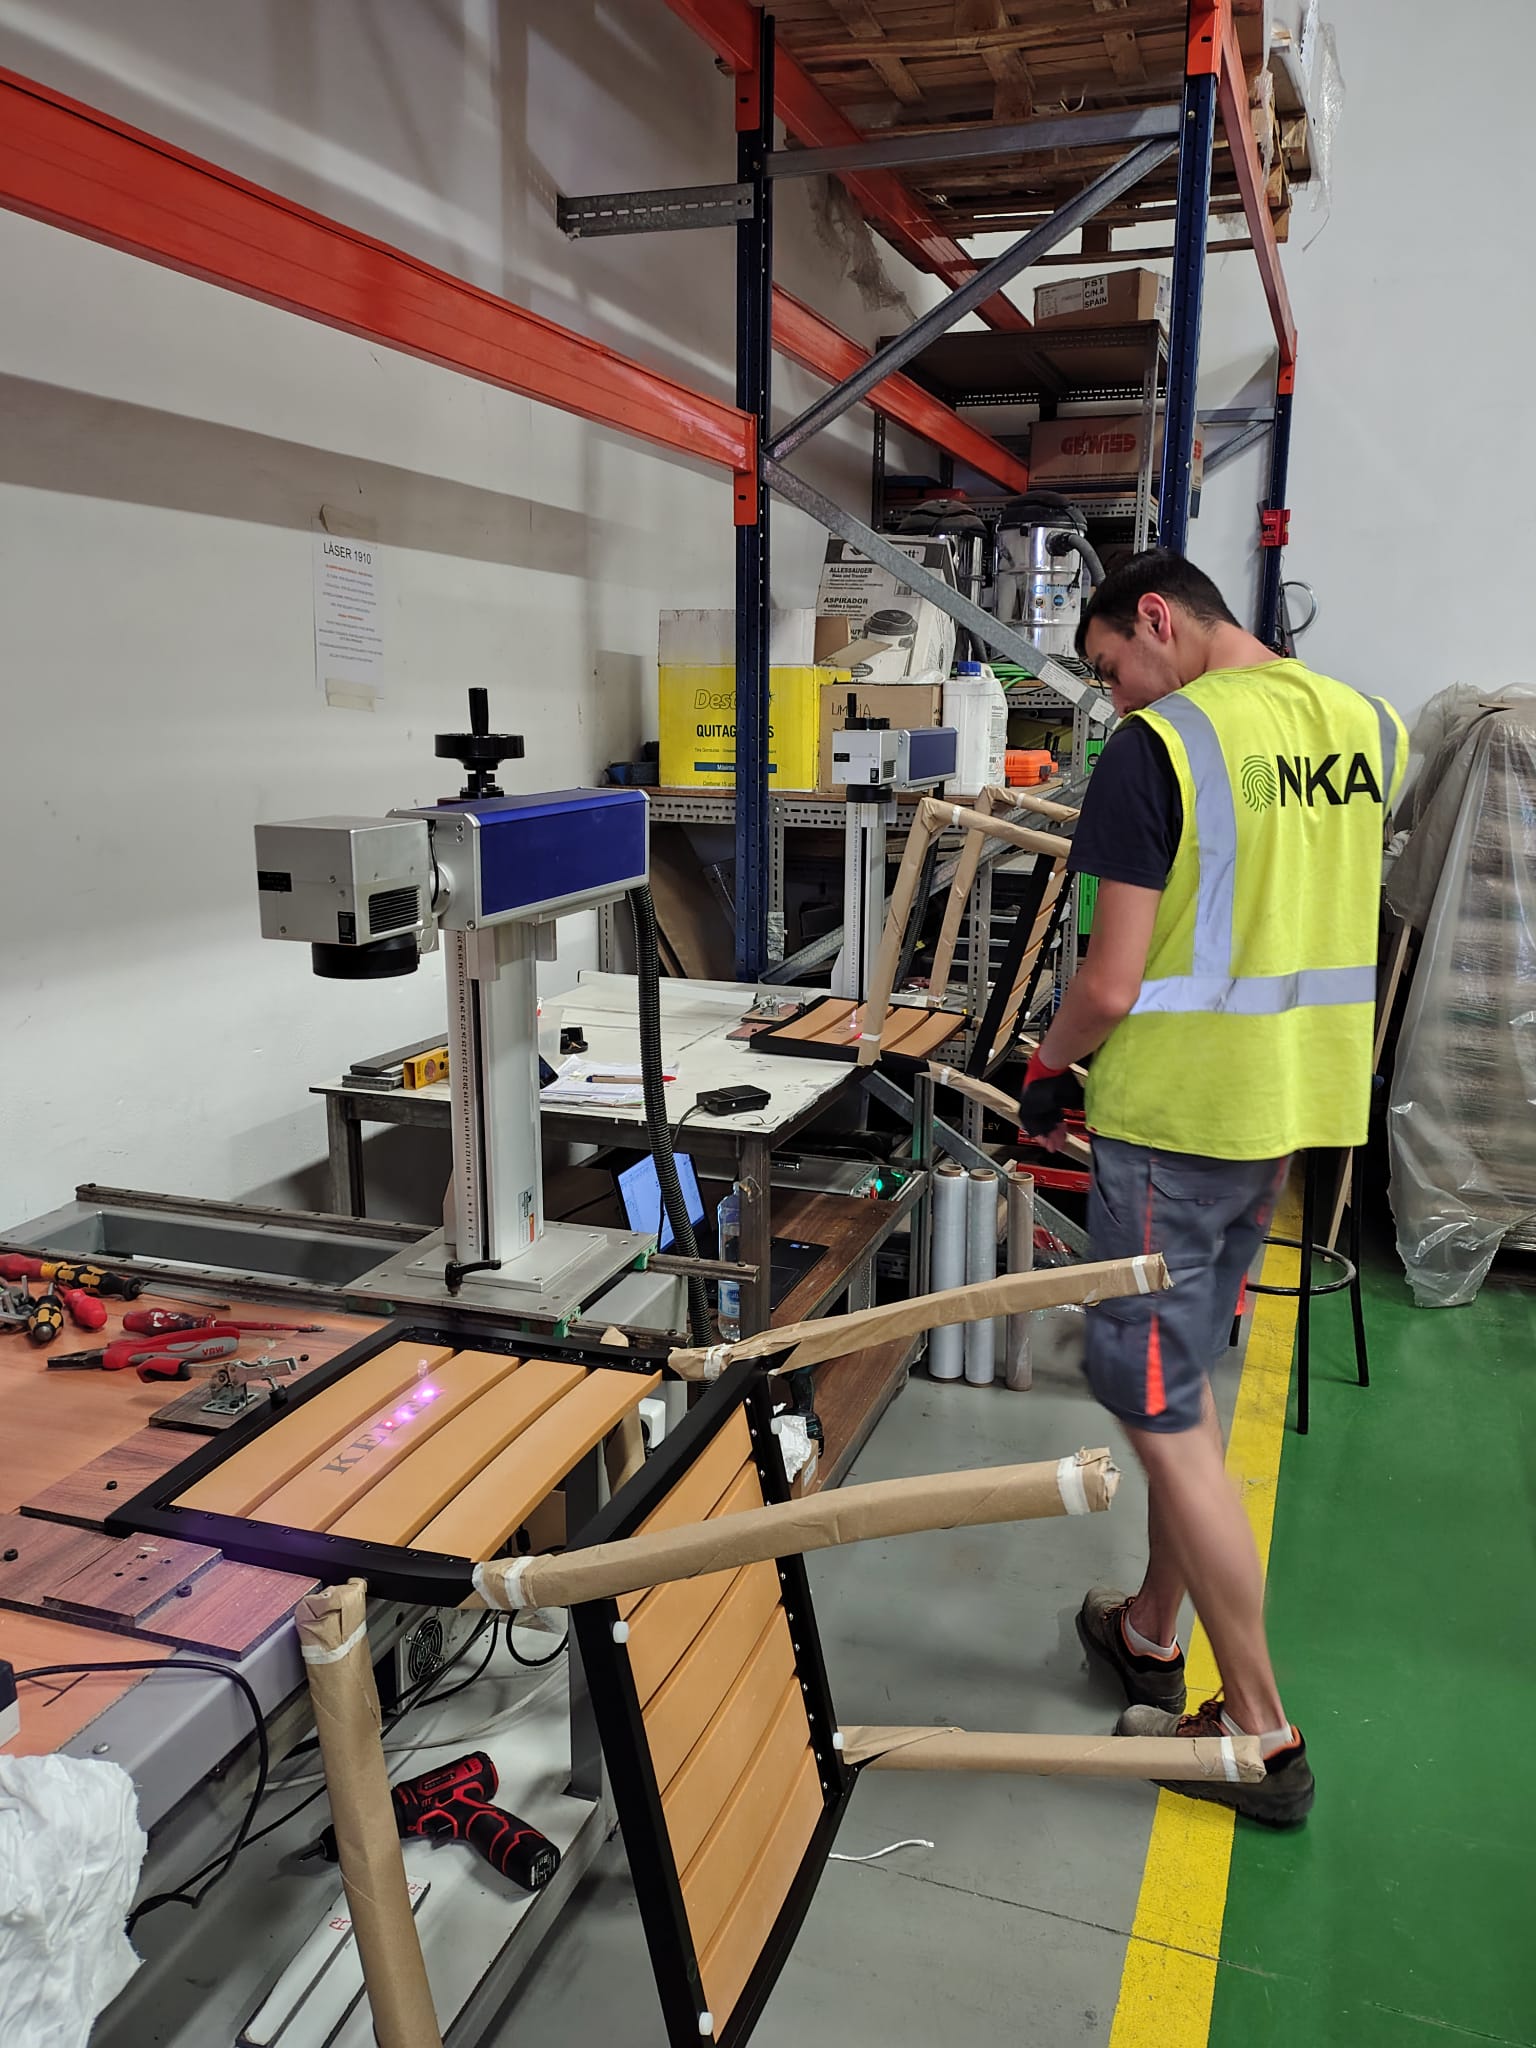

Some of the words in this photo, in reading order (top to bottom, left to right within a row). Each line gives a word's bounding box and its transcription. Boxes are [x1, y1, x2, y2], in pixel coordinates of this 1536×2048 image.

[1085, 278, 1104, 288] FST
[1085, 297, 1107, 308] SPAIN
[354, 550, 372, 565] 1910
